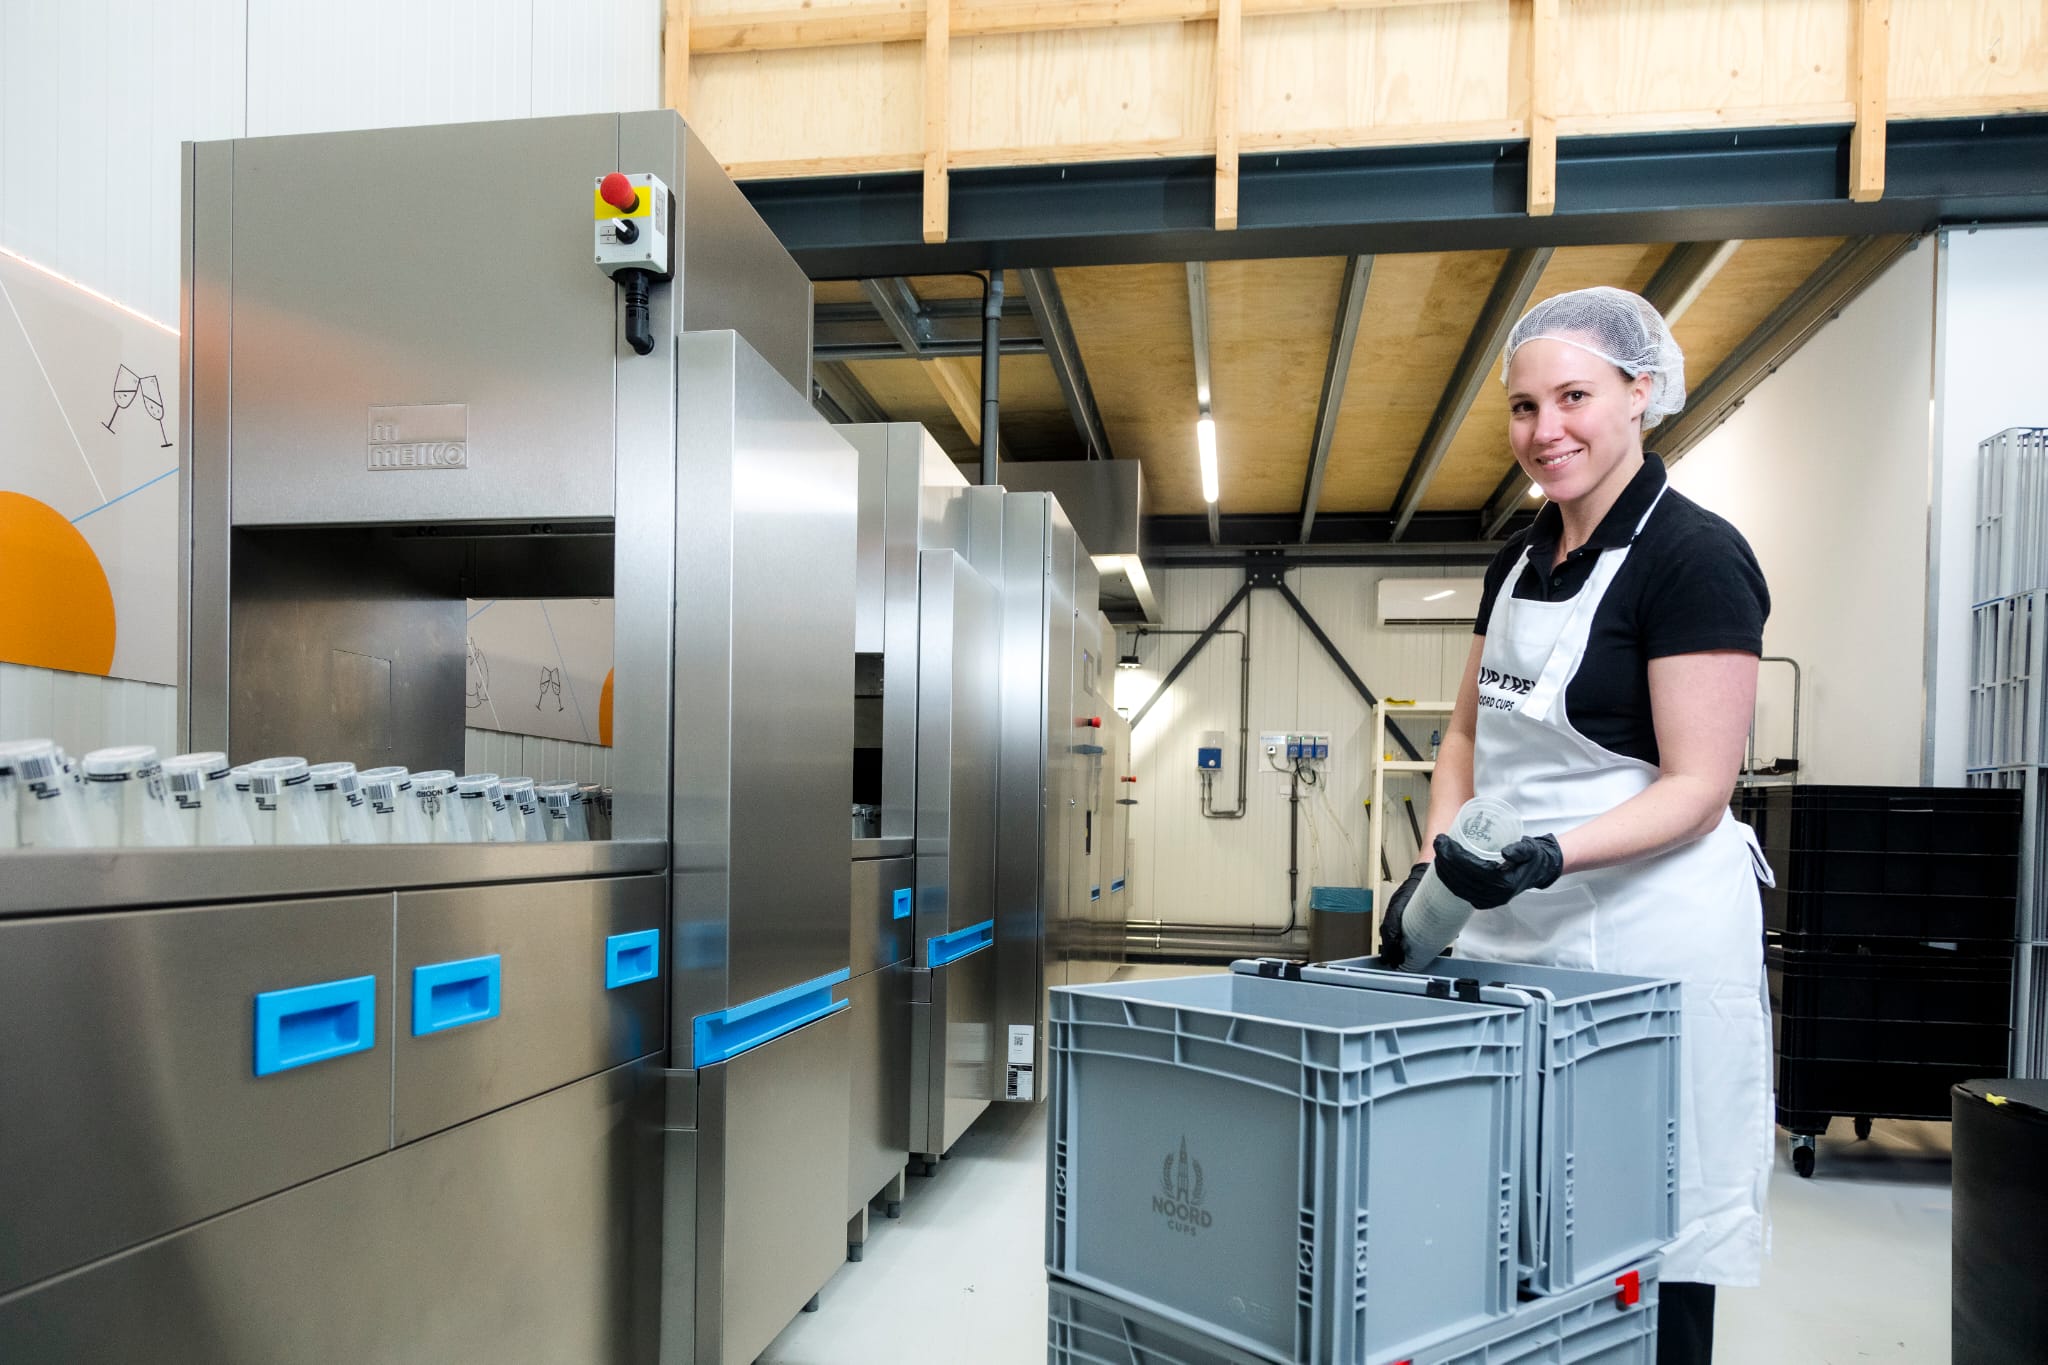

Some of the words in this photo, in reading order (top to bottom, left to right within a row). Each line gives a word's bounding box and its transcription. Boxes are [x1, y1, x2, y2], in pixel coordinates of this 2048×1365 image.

[1479, 666, 1500, 685] UP
[1478, 695, 1495, 707] OORD
[1495, 699, 1515, 711] CUPS
[1152, 1195, 1212, 1228] NOORD
[1168, 1220, 1196, 1237] CUPS
